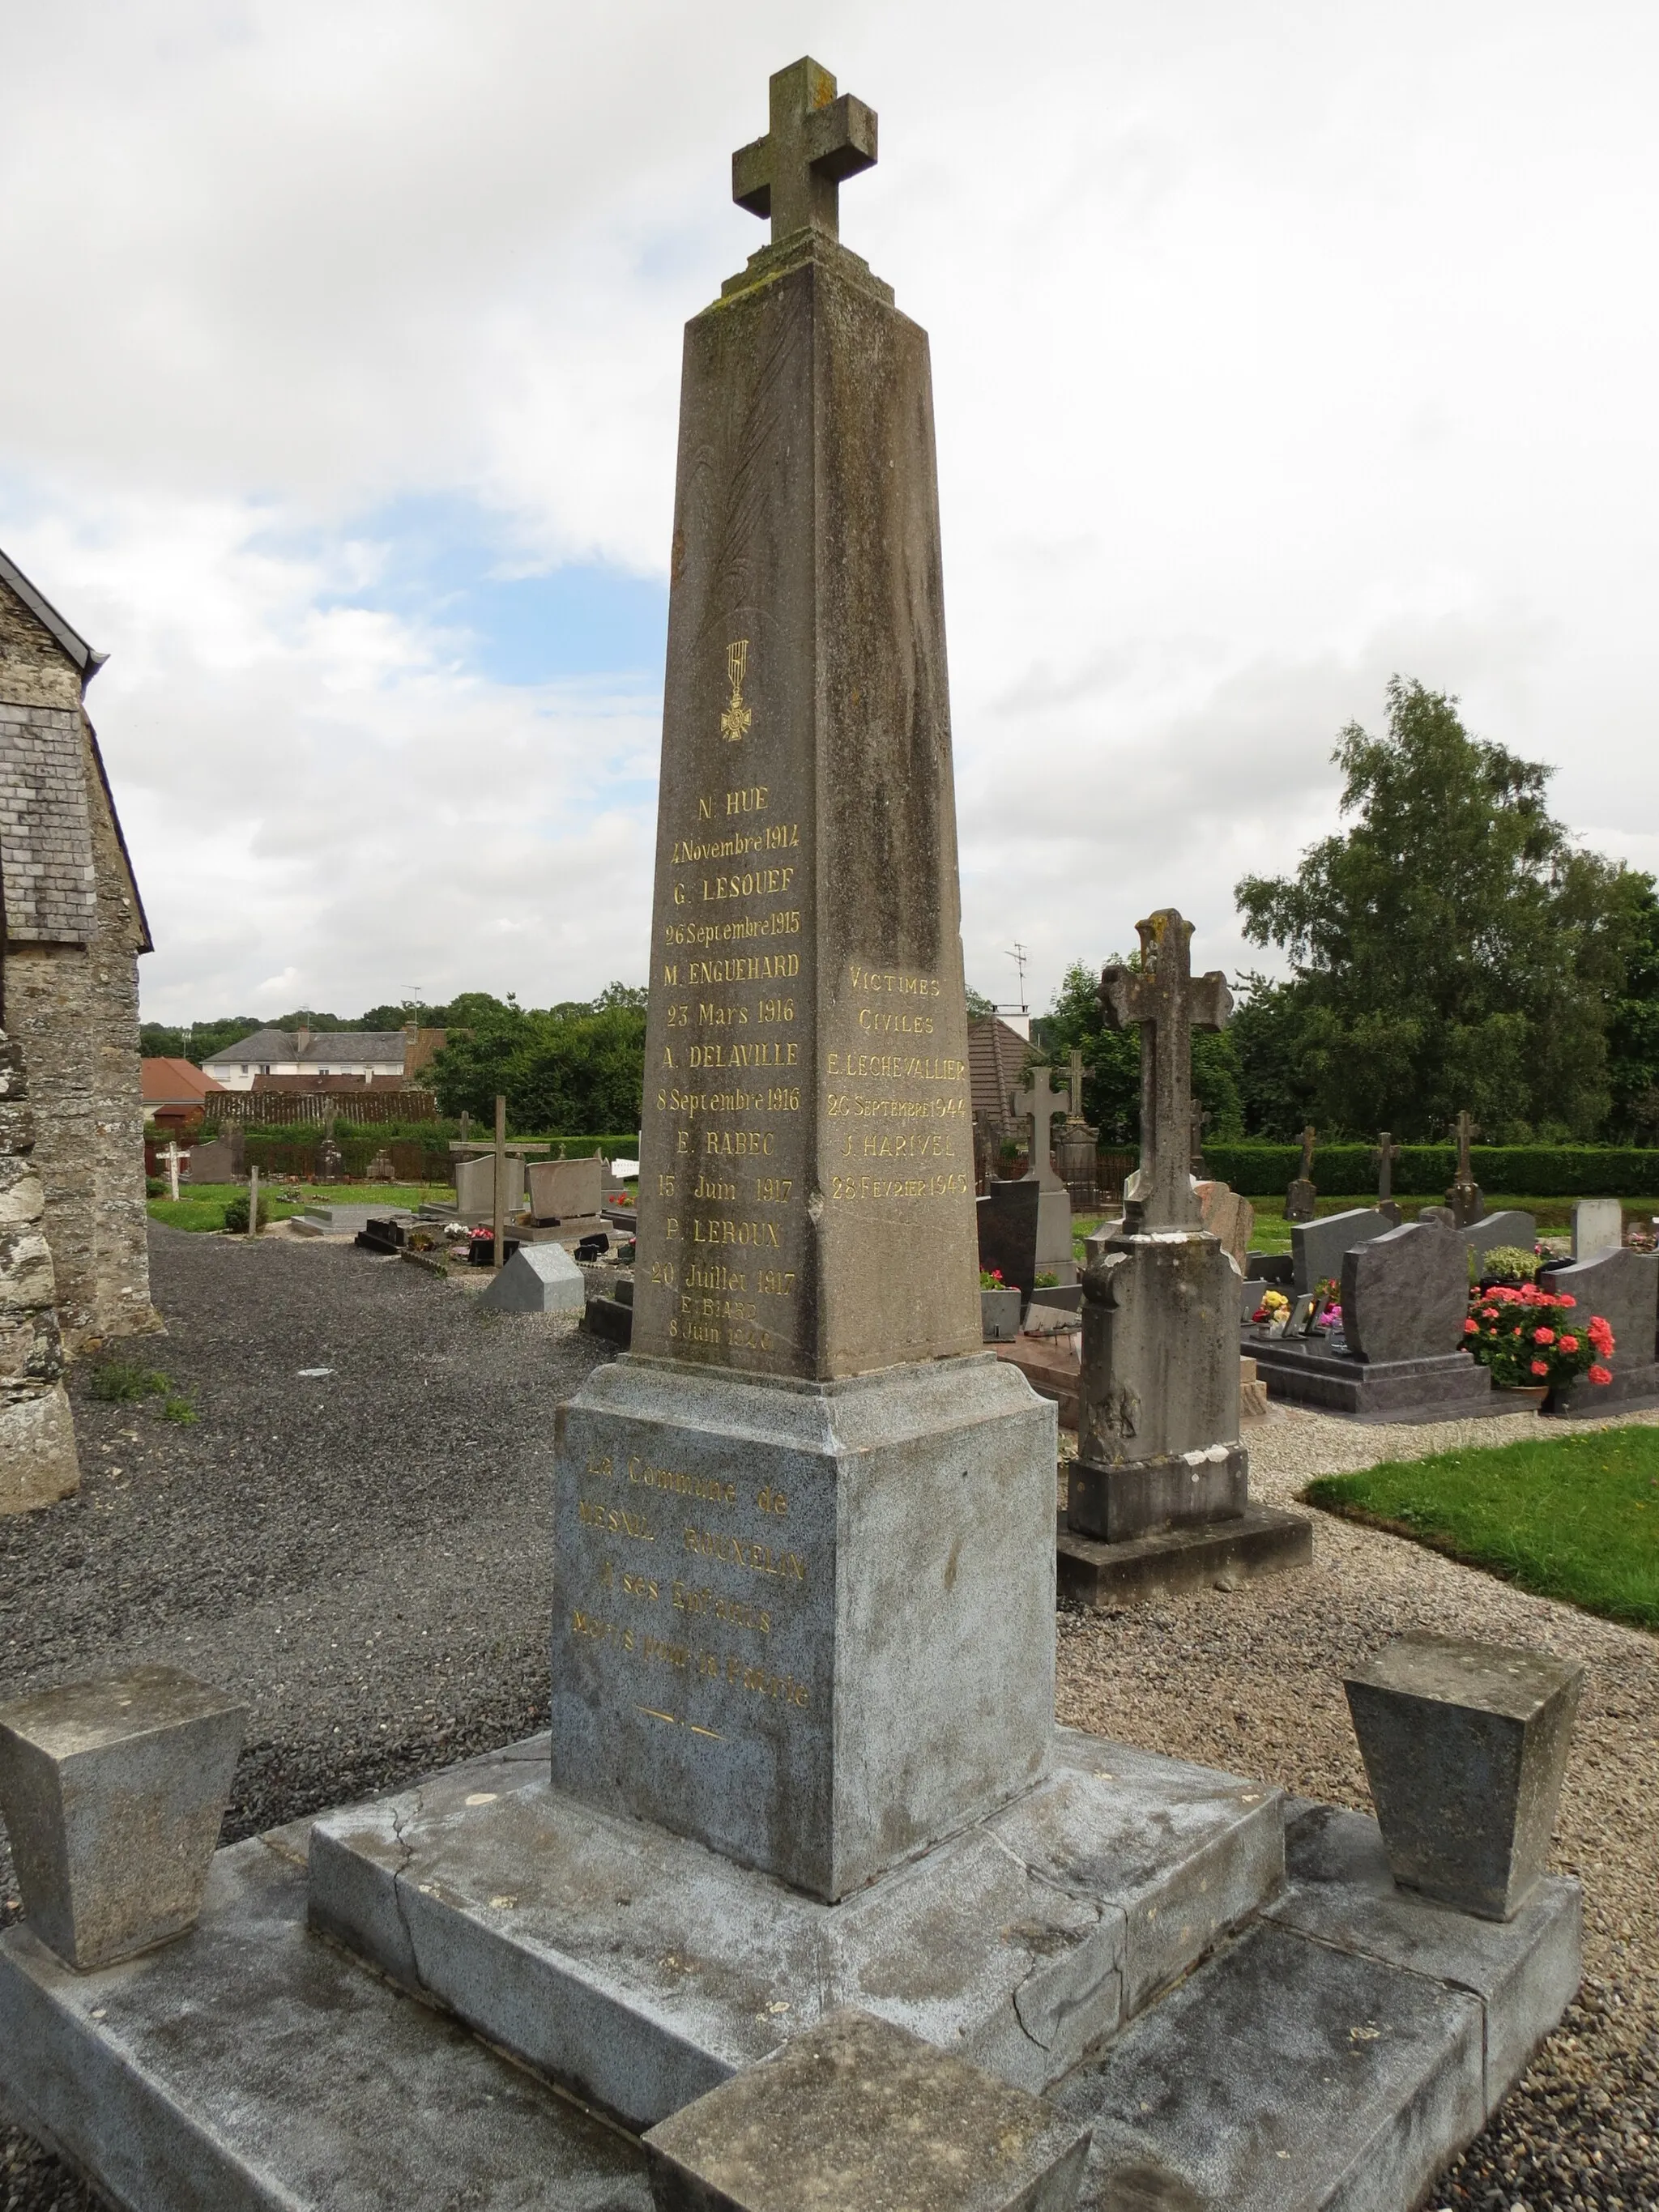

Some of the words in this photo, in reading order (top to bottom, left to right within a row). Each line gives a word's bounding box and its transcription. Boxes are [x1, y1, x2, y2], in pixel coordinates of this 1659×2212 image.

[727, 786, 768, 816] HUE
[671, 842, 682, 863] 4
[681, 833, 762, 863] Novembre
[766, 824, 800, 850] 1914
[674, 883, 691, 904] G.
[703, 868, 794, 901] LESOUEF
[665, 923, 684, 946] 26
[686, 916, 769, 948] Septembre
[770, 910, 800, 936] 1915
[664, 965, 683, 987] M.
[689, 953, 800, 984] ENGUEHARD
[667, 1004, 688, 1027] 23
[699, 1003, 748, 1026] Mars
[757, 998, 794, 1024] 1916
[662, 1046, 679, 1068] A.
[689, 1042, 798, 1068] DELAVILLE
[846, 1054, 966, 1080] LECHEVALLIER
[656, 1089, 666, 1110] 8
[670, 1088, 764, 1119] Septembre
[767, 1087, 800, 1110] 1916
[930, 1097, 966, 1118] 1944
[677, 1131, 694, 1153] E.
[706, 1131, 774, 1156] RABEC
[864, 1134, 955, 1157] HARIVEL
[659, 1174, 676, 1196] 15
[694, 1175, 736, 1200] Juin
[756, 1178, 792, 1203] 1917
[832, 1176, 856, 1199] 28
[930, 1174, 967, 1196] 1945
[666, 1217, 684, 1240] P.
[694, 1219, 780, 1248] LEROUX
[651, 1261, 674, 1284] 20
[685, 1264, 747, 1292] Juillet
[757, 1269, 795, 1295] 1917
[683, 1322, 720, 1344] Juin
[586, 1452, 613, 1477] La
[628, 1456, 736, 1504] Commune
[757, 1485, 789, 1515] de
[684, 1528, 804, 1579] ROUXELIN
[623, 1573, 659, 1601] ses
[727, 1656, 811, 1708] Patrie
